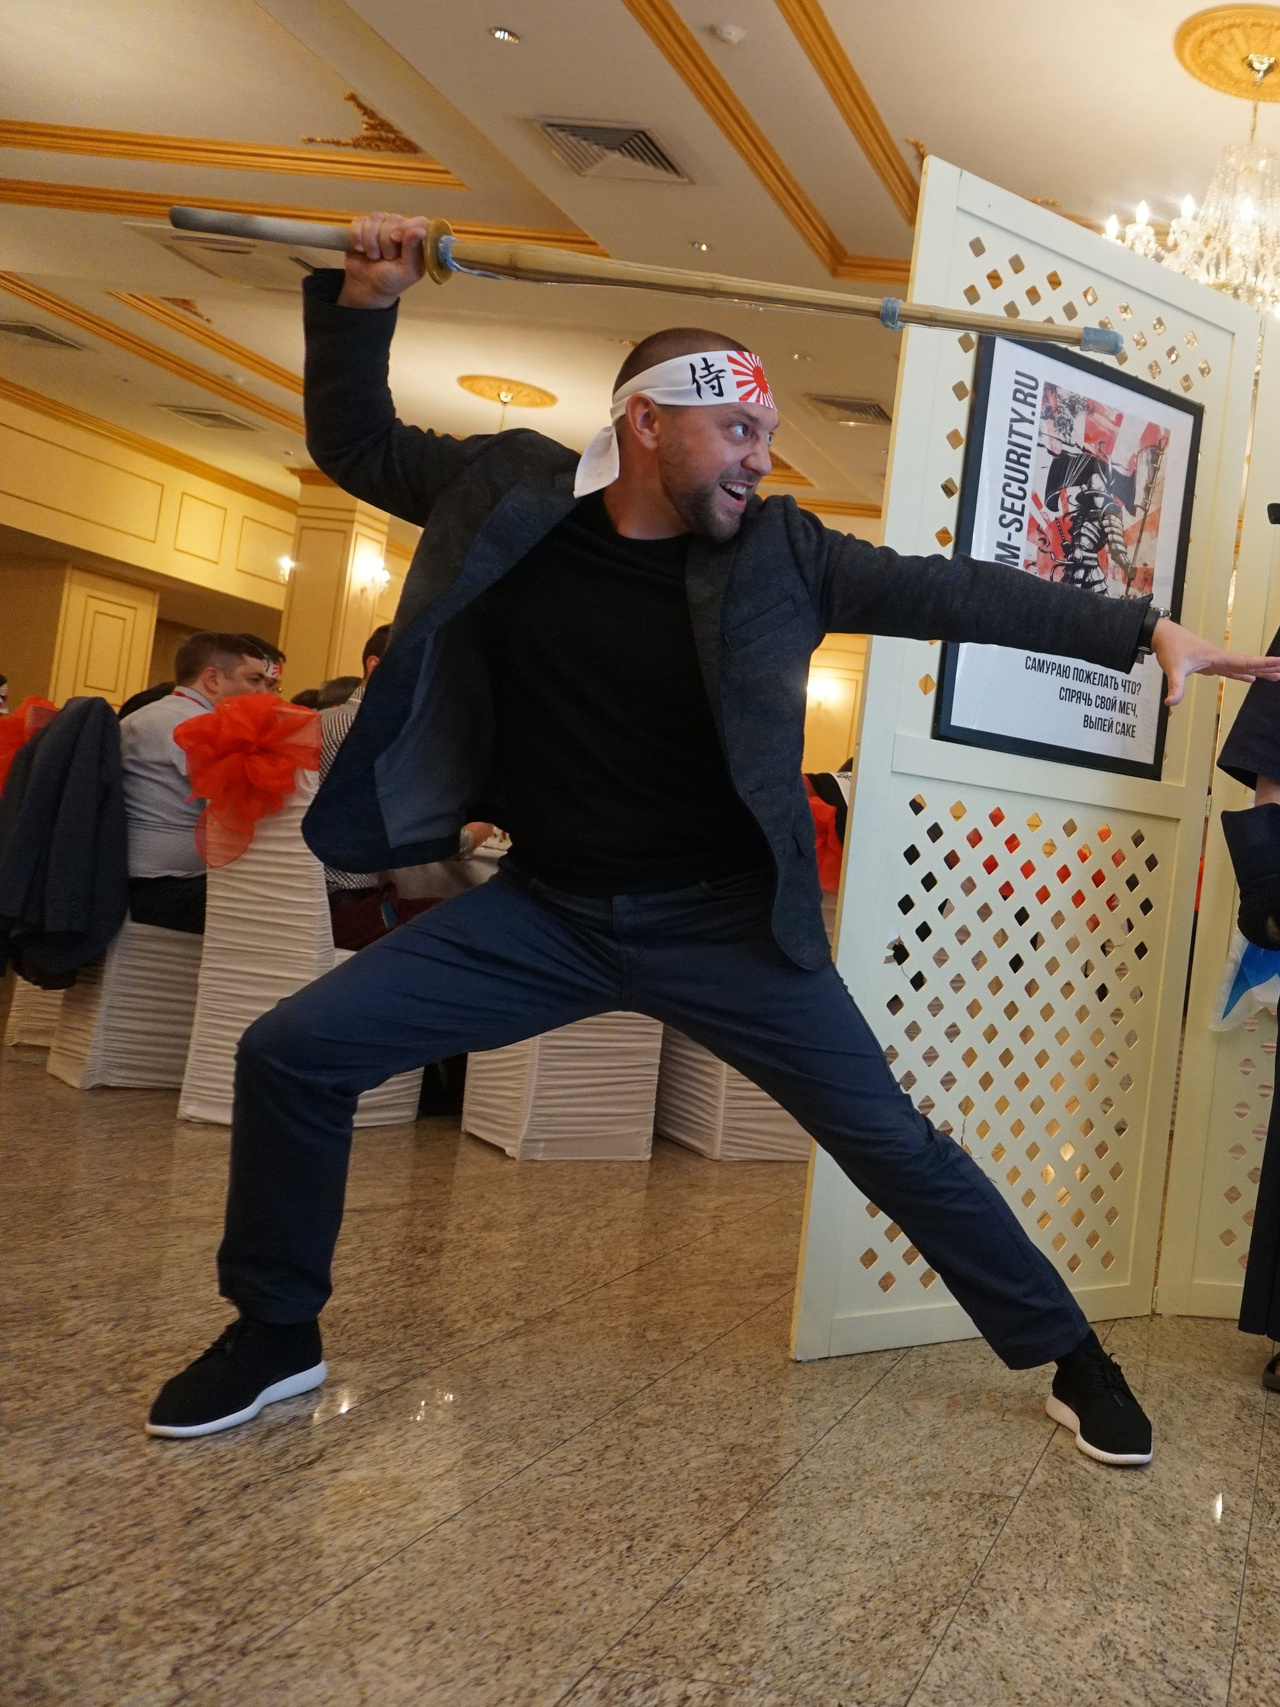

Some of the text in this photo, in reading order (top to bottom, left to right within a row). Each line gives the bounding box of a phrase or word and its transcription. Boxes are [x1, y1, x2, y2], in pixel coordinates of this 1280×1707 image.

[689, 357, 727, 399] 侍
[1024, 655, 1142, 696] САМУРАЮ ПОЖЕЛАТЬ ЧТО?
[1058, 686, 1138, 718] СПРЯЧЬ СВОЙ МЕЧ,
[1083, 714, 1137, 739] ВЫПЕЙ САКЕ
